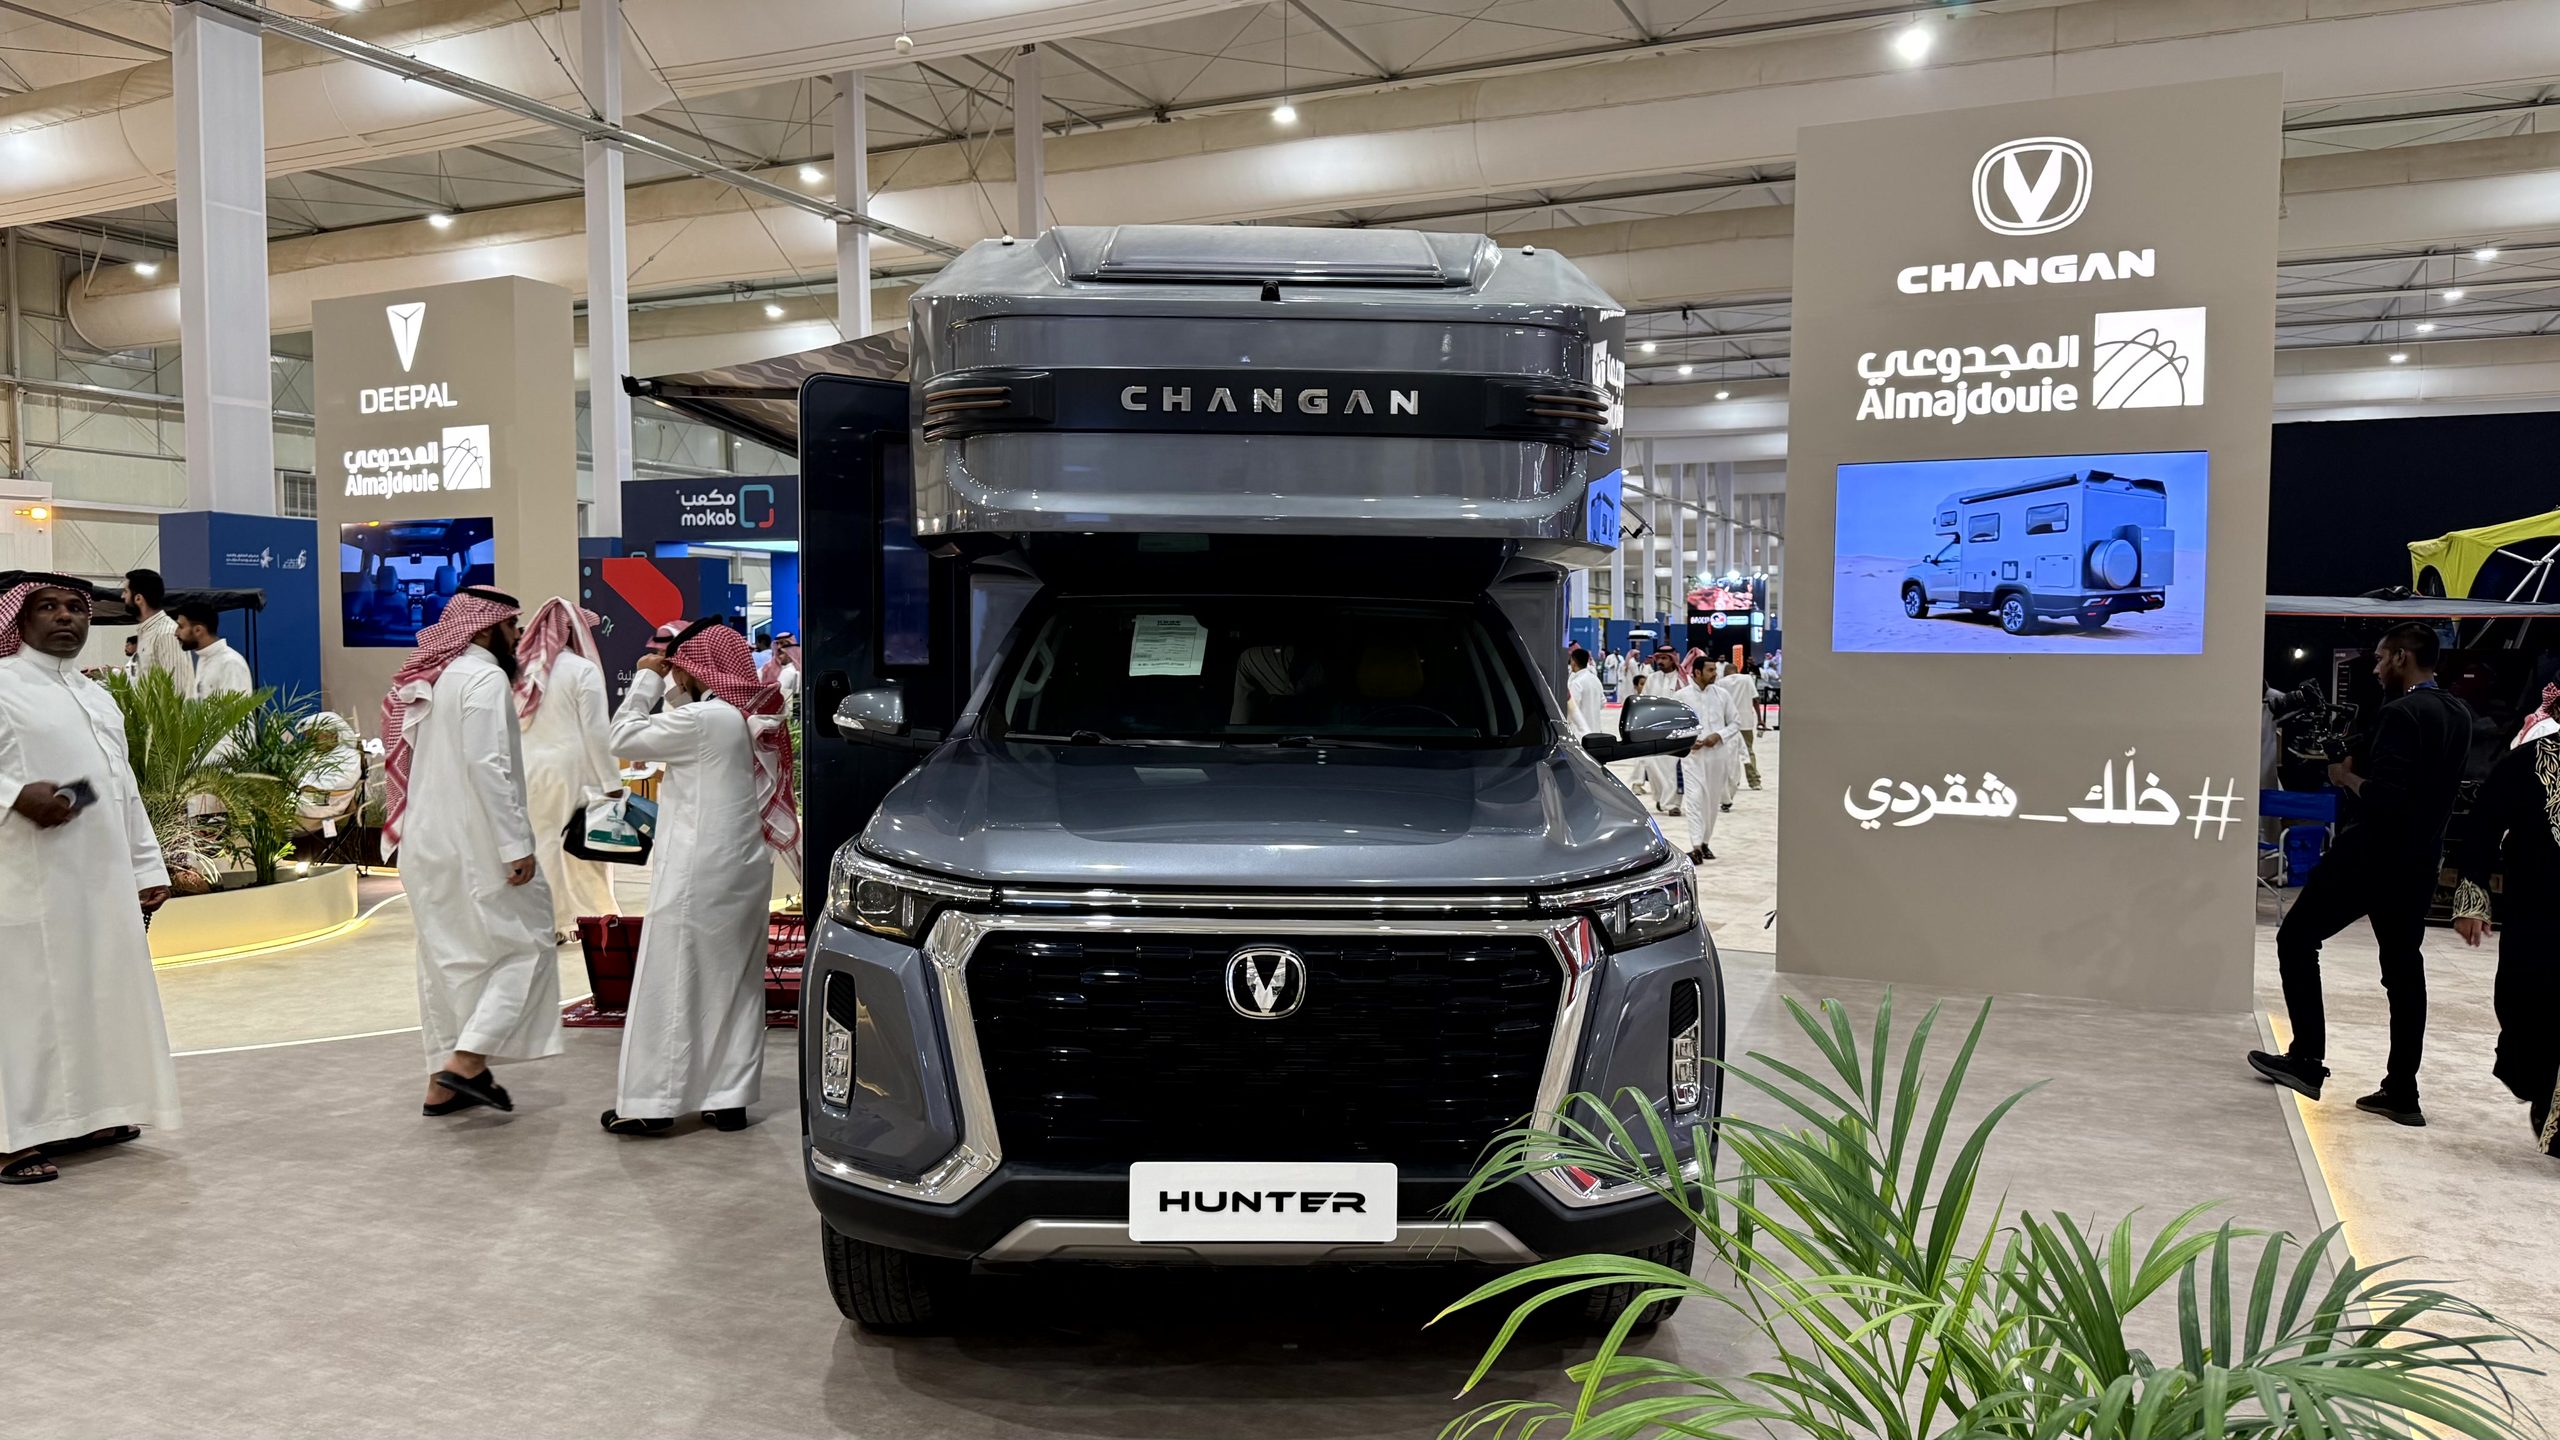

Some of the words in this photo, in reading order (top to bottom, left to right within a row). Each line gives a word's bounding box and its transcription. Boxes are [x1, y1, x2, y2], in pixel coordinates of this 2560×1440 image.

[1896, 248, 2156, 294] CHANGAN
[1856, 334, 2080, 387] المجدوعي
[360, 382, 458, 414] DEEPAL
[1120, 385, 1419, 416] CHANGAN
[1855, 376, 2079, 425] Almajdouie
[343, 441, 439, 474] المجدوعي
[344, 468, 440, 500] Almajdouie
[680, 488, 736, 511] مكعب
[681, 508, 737, 527] mokab
[1158, 1190, 1368, 1214] HUNTER
